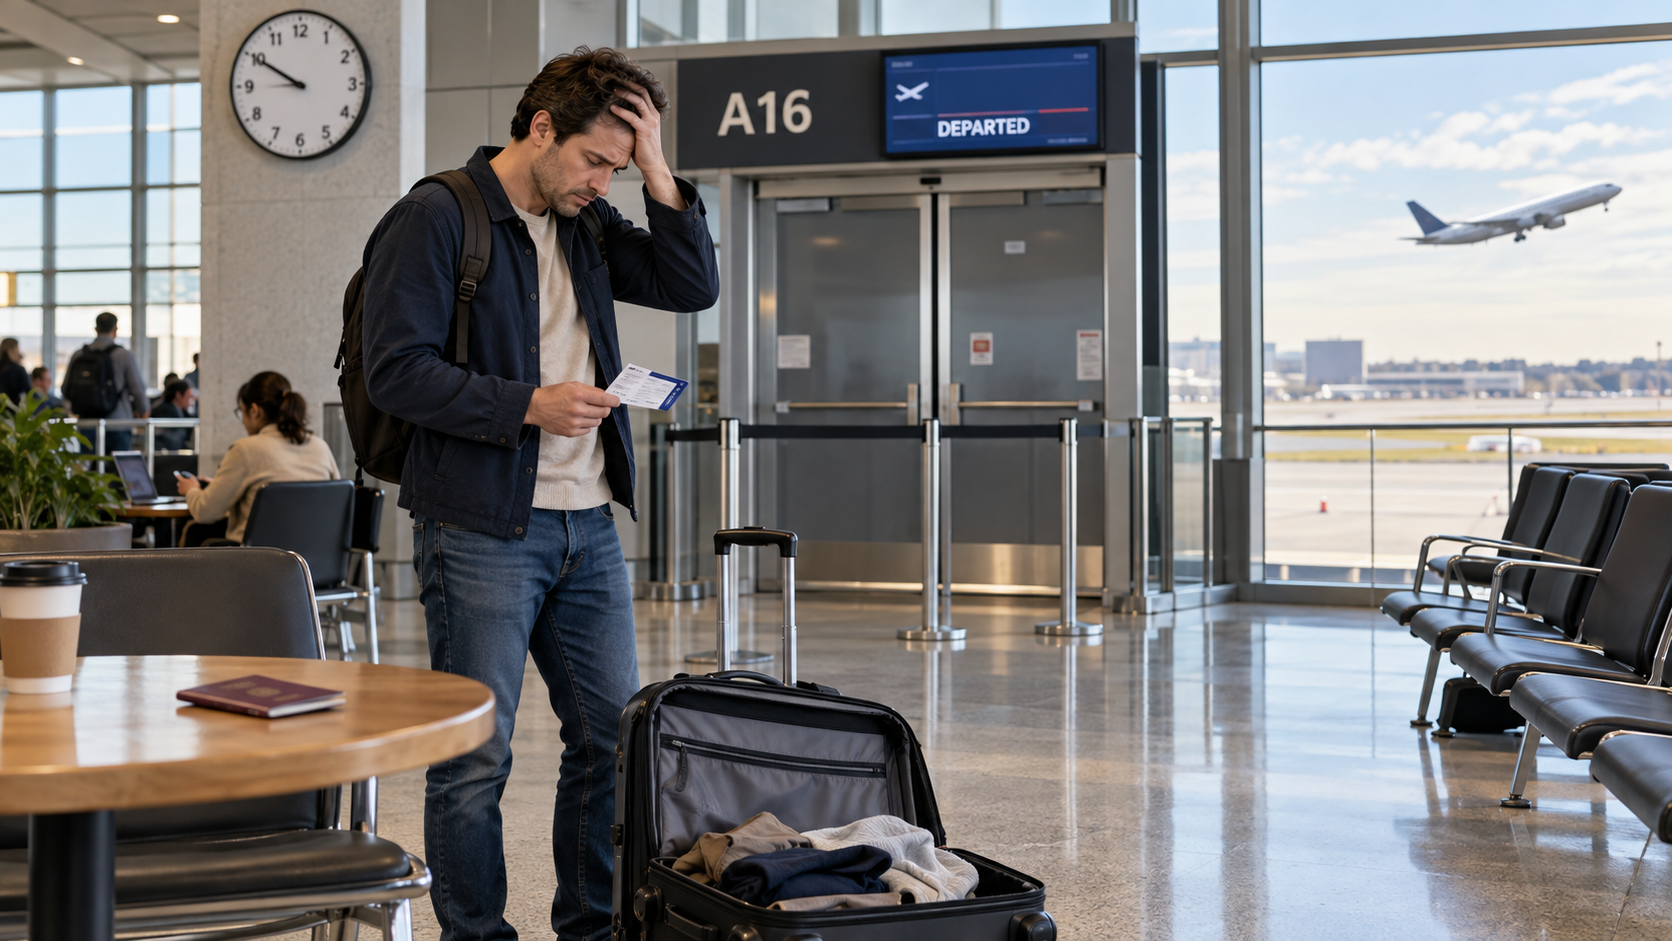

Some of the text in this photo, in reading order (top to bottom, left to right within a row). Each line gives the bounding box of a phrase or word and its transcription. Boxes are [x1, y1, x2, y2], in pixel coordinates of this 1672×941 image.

[292, 24, 308, 38] 12
[323, 31, 329, 44] 1
[269, 33, 282, 46] 11
[251, 52, 266, 66] 10
[340, 50, 350, 64] 2
[245, 80, 254, 93] 9
[348, 77, 357, 91] 3
[252, 107, 262, 121] 8
[340, 105, 350, 119] 4
[717, 89, 813, 136] A16
[271, 127, 281, 140] 7
[321, 125, 331, 139] 5
[937, 116, 1031, 138] DEPARTED
[295, 133, 305, 147] 6
